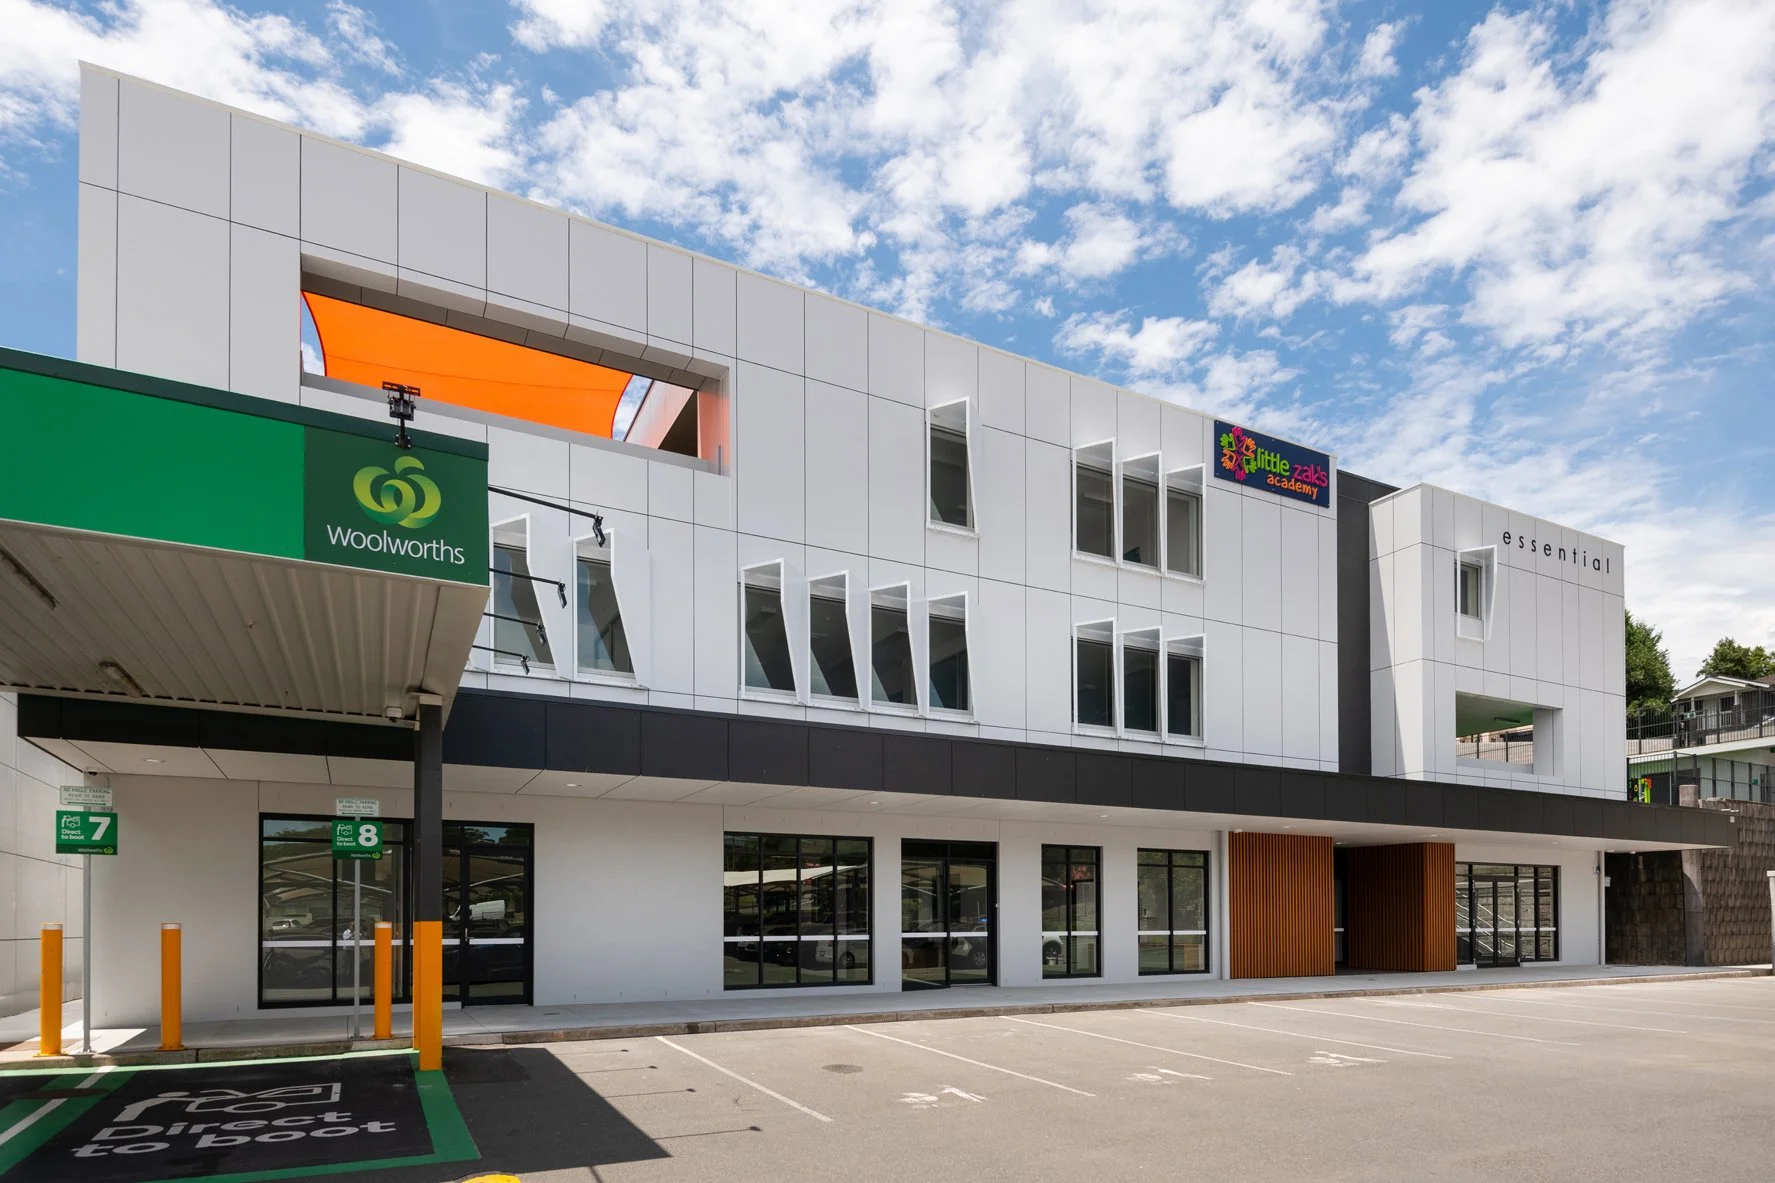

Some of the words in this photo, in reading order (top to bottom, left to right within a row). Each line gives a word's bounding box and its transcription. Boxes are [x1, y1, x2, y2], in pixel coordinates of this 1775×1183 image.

[1256, 447, 1290, 476] little
[1292, 464, 1328, 487] zak's
[1266, 473, 1318, 500] academy
[326, 524, 465, 565] Woolworths
[1502, 531, 1610, 574] essential
[88, 816, 111, 840] 7
[358, 824, 379, 847] 8
[71, 1142, 170, 1158] to
[195, 1121, 397, 1148] boot
[91, 1111, 352, 1141] Direct
